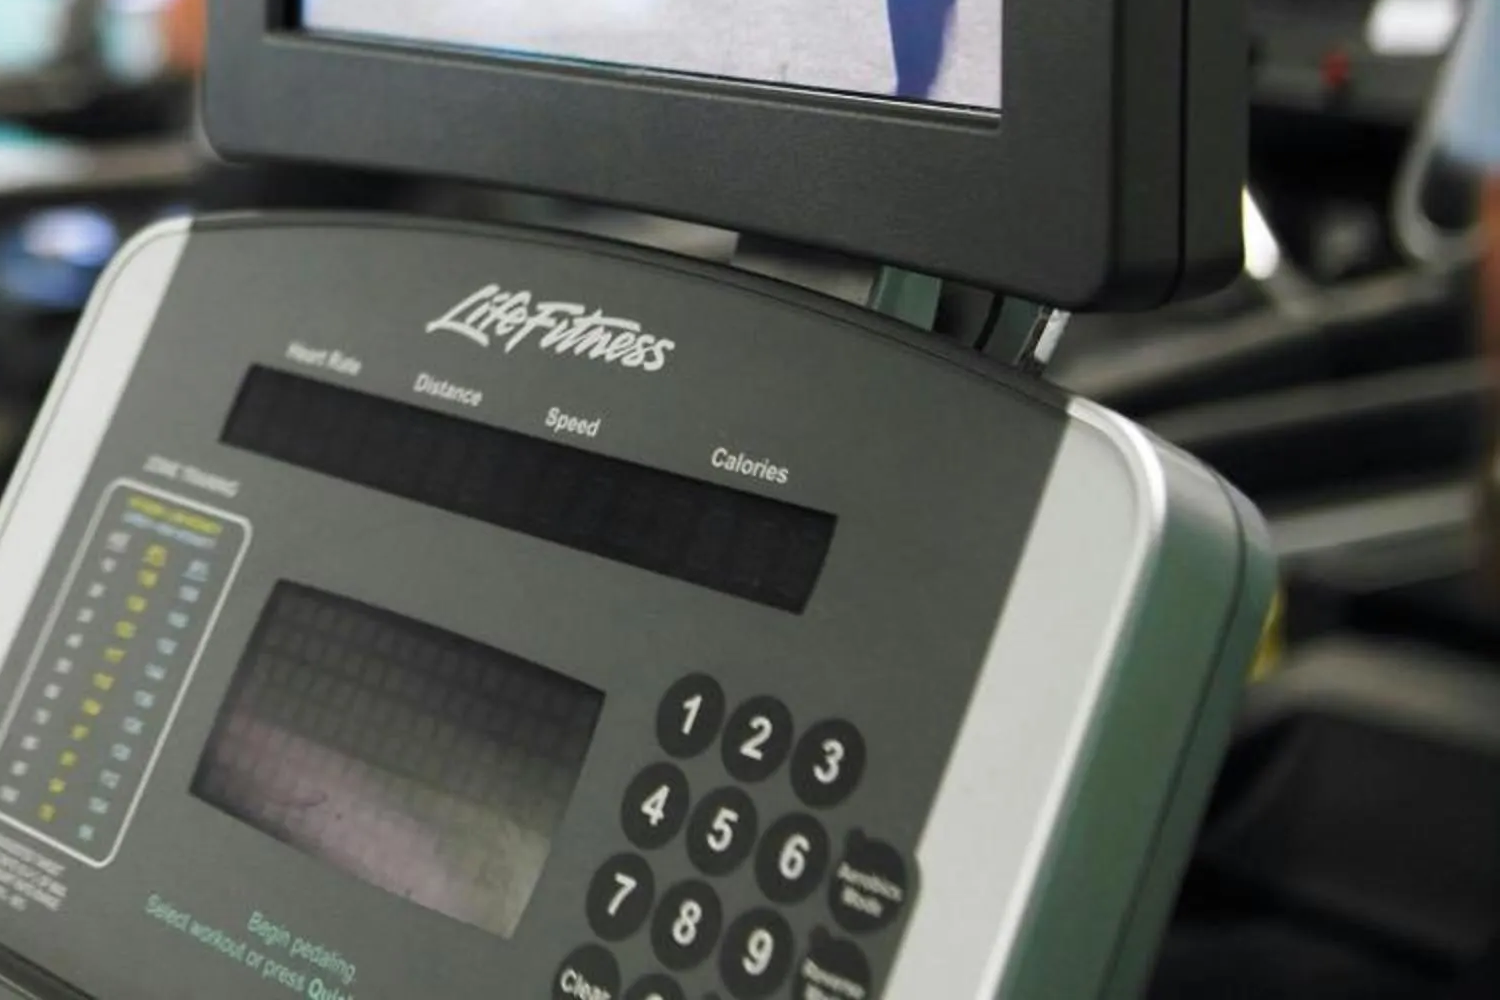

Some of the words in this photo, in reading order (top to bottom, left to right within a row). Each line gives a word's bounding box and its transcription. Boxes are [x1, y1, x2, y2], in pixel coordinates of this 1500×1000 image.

[413, 373, 483, 407] Distance
[545, 407, 601, 437] Speed
[711, 447, 790, 484] Calories
[681, 695, 703, 735] 1
[739, 716, 773, 761] 2
[812, 739, 845, 784] 3
[640, 784, 670, 826] 4
[706, 807, 739, 852] 5
[779, 833, 811, 880] 6
[146, 894, 192, 933] Select
[189, 919, 247, 961] workout
[246, 951, 265, 970] or
[262, 959, 306, 992] press
[308, 978, 354, 1000] Qui
[248, 911, 291, 947] Begin
[607, 872, 637, 917] 7
[672, 900, 703, 945] 8
[741, 929, 774, 975] 9
